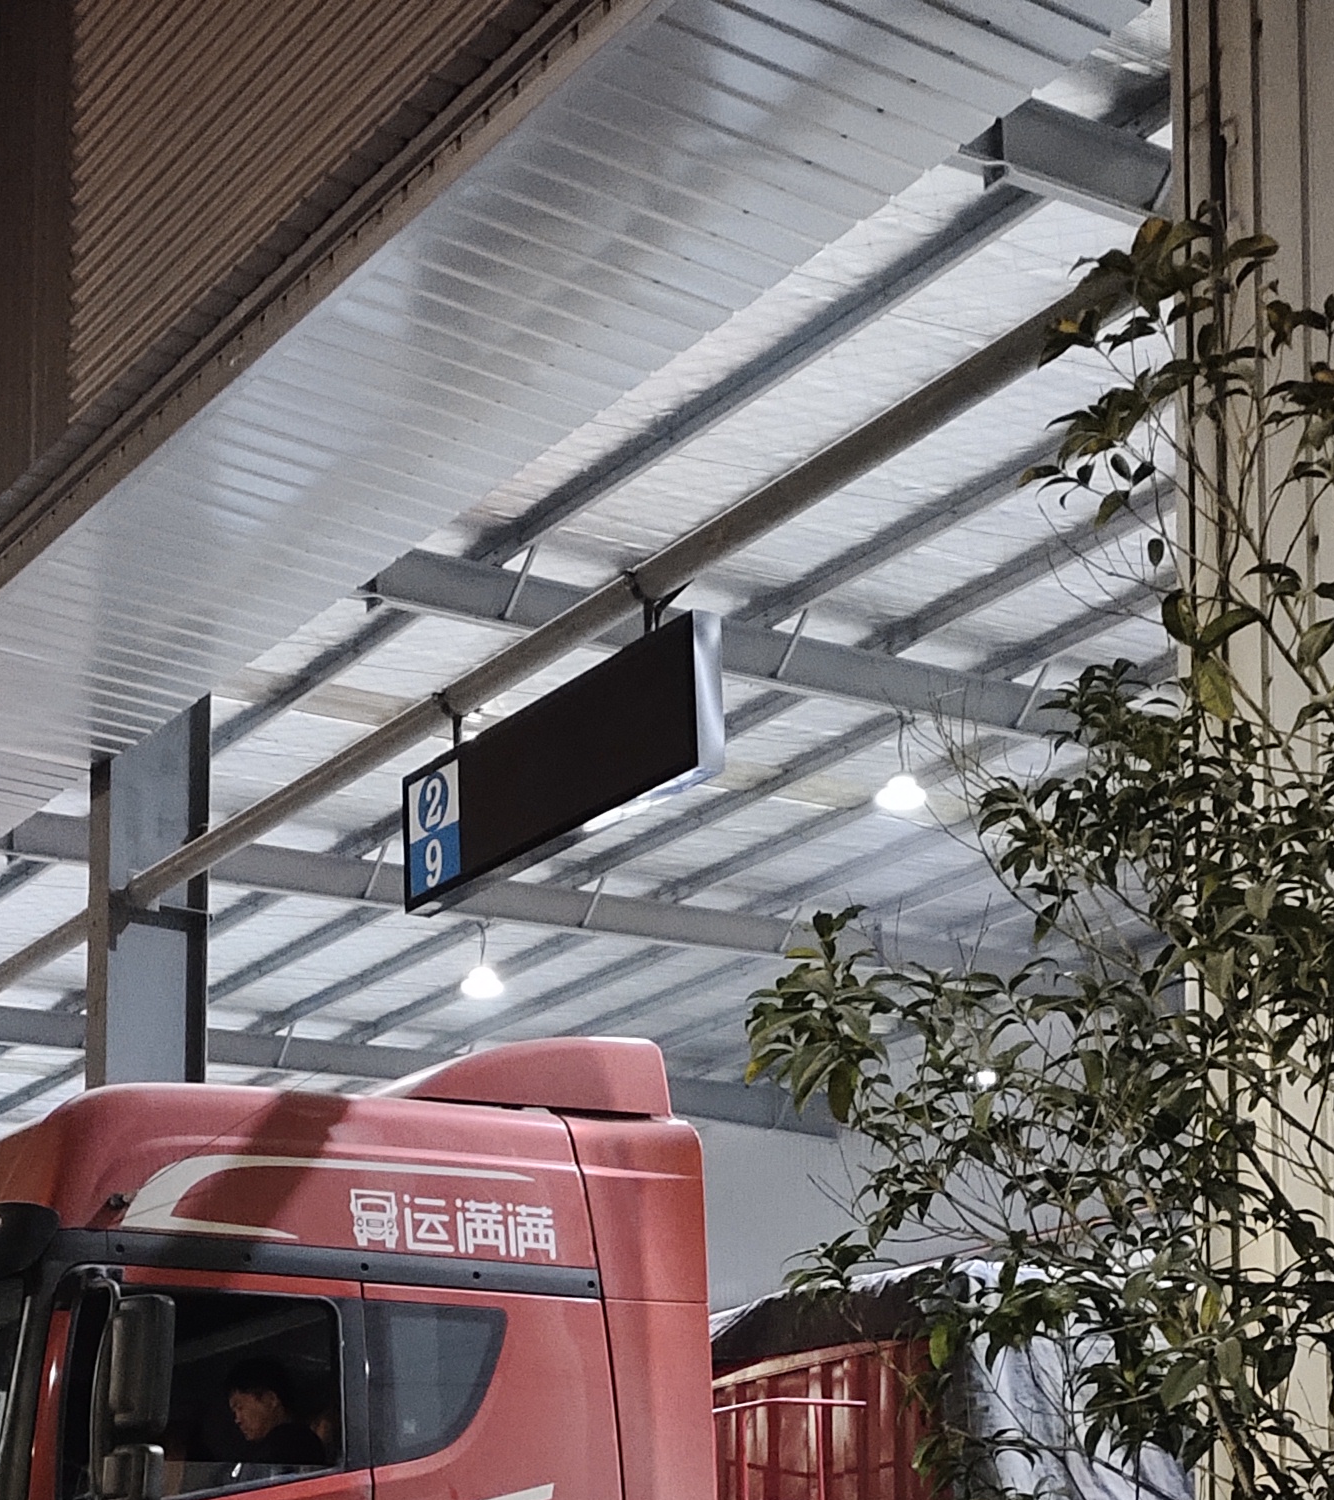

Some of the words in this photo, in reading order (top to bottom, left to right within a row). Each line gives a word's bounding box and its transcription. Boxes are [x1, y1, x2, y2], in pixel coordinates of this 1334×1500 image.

[425, 777, 443, 826] 2
[425, 839, 443, 888] 9
[403, 1194, 556, 1260] 运满满
